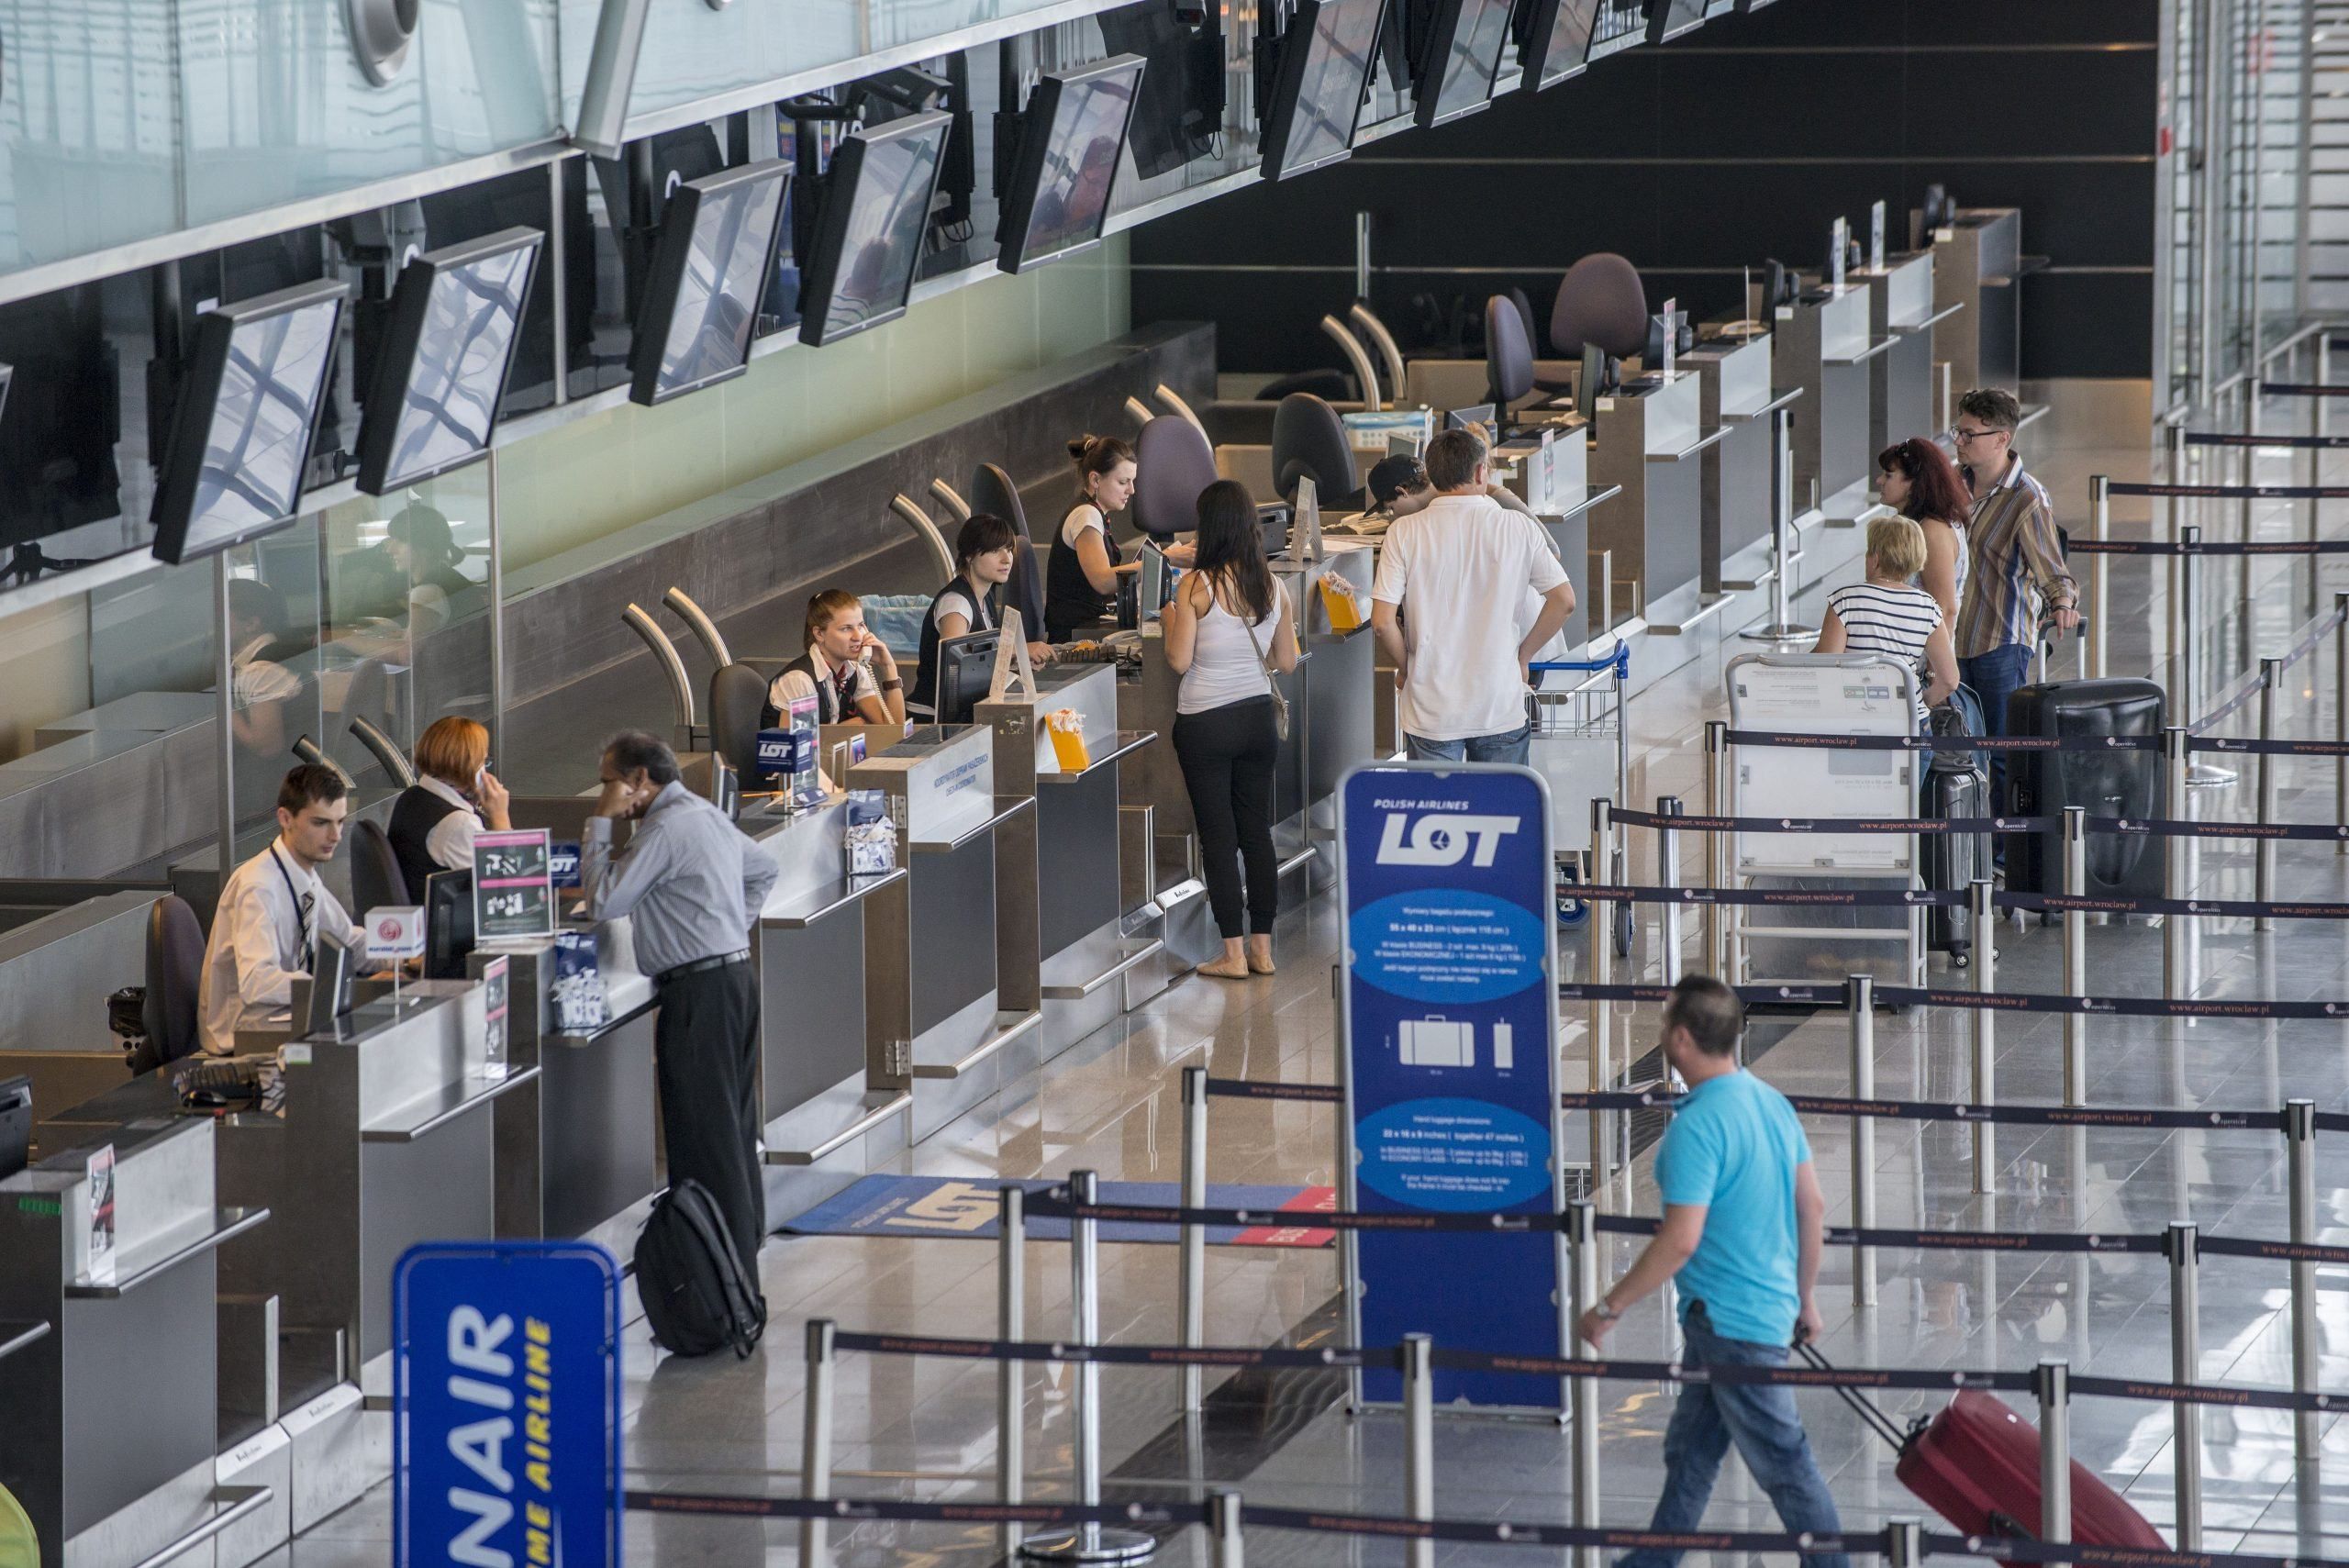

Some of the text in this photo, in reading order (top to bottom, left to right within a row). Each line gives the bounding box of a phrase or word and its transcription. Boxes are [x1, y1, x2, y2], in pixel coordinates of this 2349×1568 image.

[1774, 736, 1857, 749] www.airport.wroclaw.pl
[1976, 739, 2061, 748] www.airport.wroclaw.pl
[758, 743, 793, 758] LOT
[1374, 799, 1469, 811] POLISH AIRLINES
[1649, 817, 1734, 829] www.airport.wroclaw.pl
[1859, 820, 1947, 830] www.airport.wroclaw.pl
[2198, 825, 2288, 836] www.airport.wroclaw.pl
[1375, 813, 1521, 867] LOT
[1764, 894, 1854, 903] www.airport.wroclaw.pl
[2043, 898, 2136, 909] www.airport.wroclaw.pl
[1931, 995, 2028, 1007] www.airport.wroclaw.pl
[2170, 1003, 2271, 1014] www.airport.wroclaw.pl
[2048, 1113, 2152, 1125] www.airport.wroclaw.pl
[525, 1316, 551, 1493] AIRLINE
